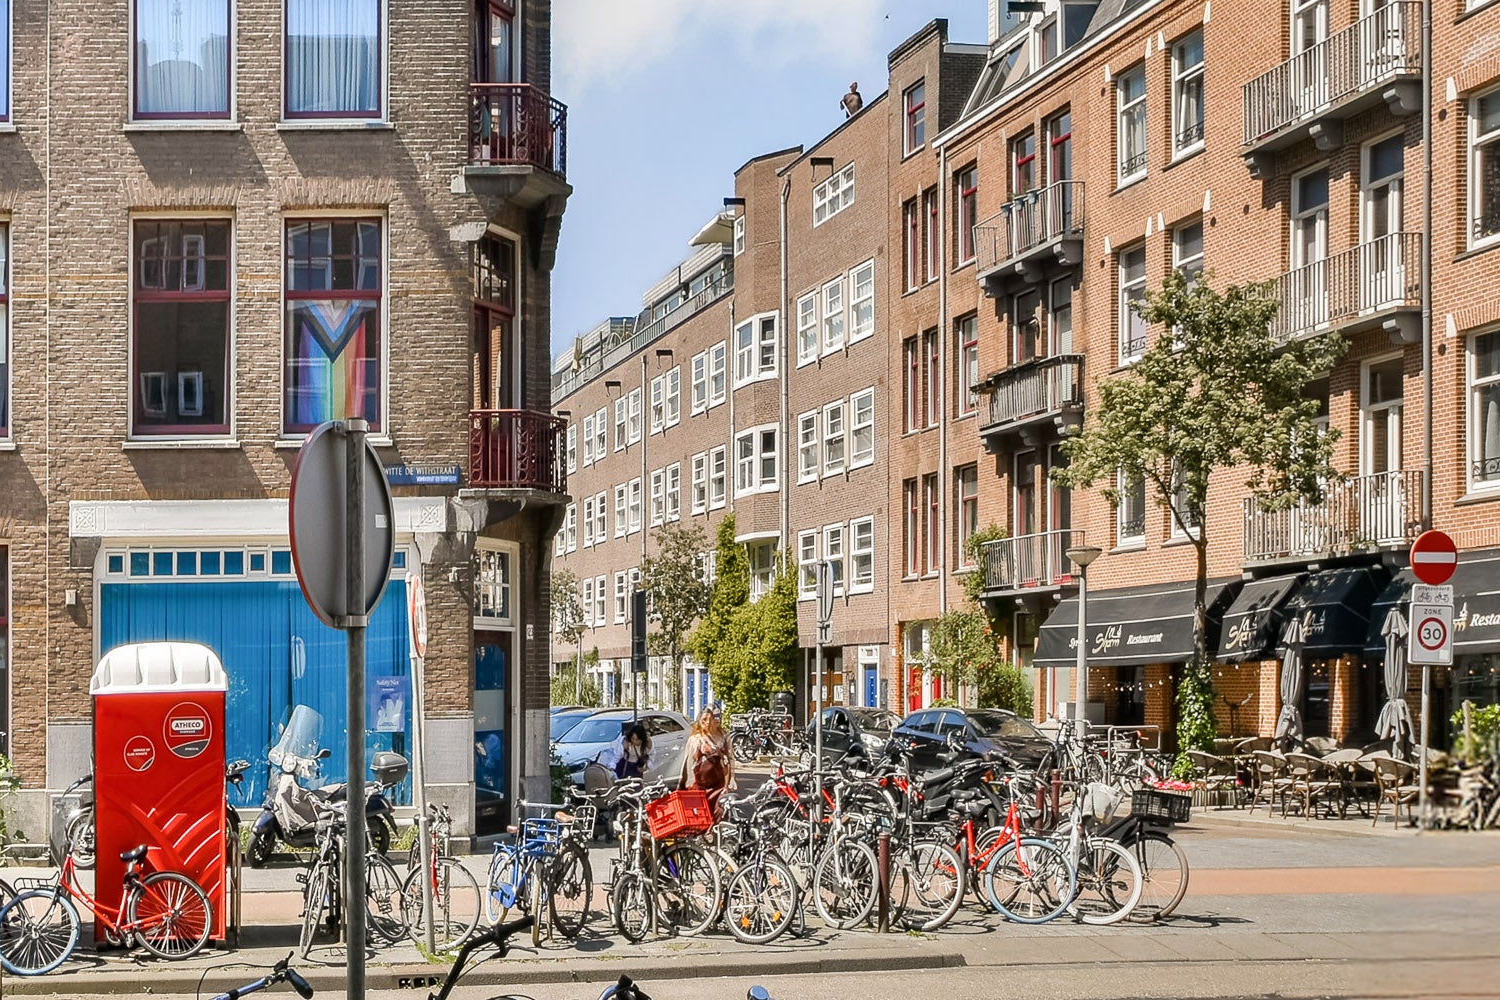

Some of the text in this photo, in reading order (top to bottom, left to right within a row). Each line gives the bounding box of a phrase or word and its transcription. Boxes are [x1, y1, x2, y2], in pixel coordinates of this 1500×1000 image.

[405, 467, 414, 475] DE
[416, 466, 456, 475] WITHSTRAAT
[1126, 633, 1163, 645] Restaurant
[1423, 628, 1442, 640] 30
